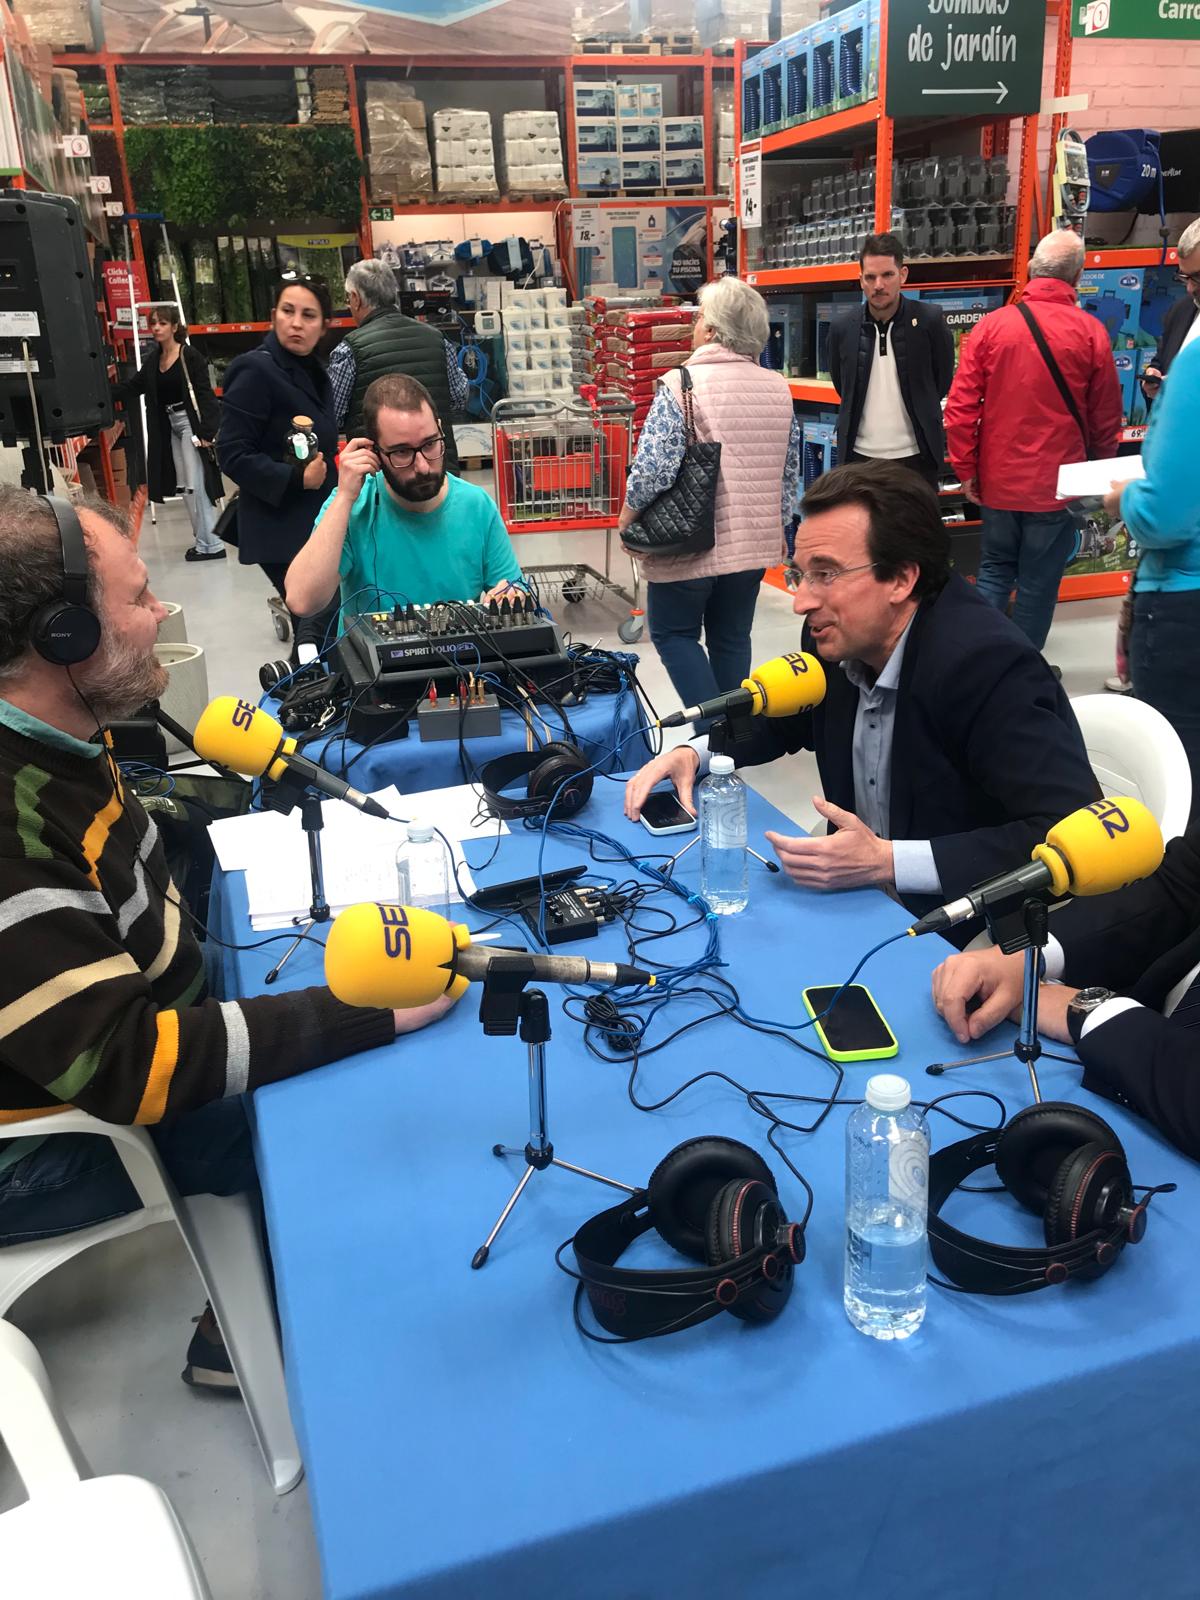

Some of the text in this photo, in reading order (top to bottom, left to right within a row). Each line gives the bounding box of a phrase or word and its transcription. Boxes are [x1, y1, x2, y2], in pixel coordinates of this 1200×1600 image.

[908, 24, 1017, 71] de jardín
[1141, 163, 1157, 178] 20 m
[107, 268, 123, 276] Click
[108, 276, 129, 285] Collec
[946, 313, 990, 325] GARDEN
[404, 646, 430, 658] SPIRIT
